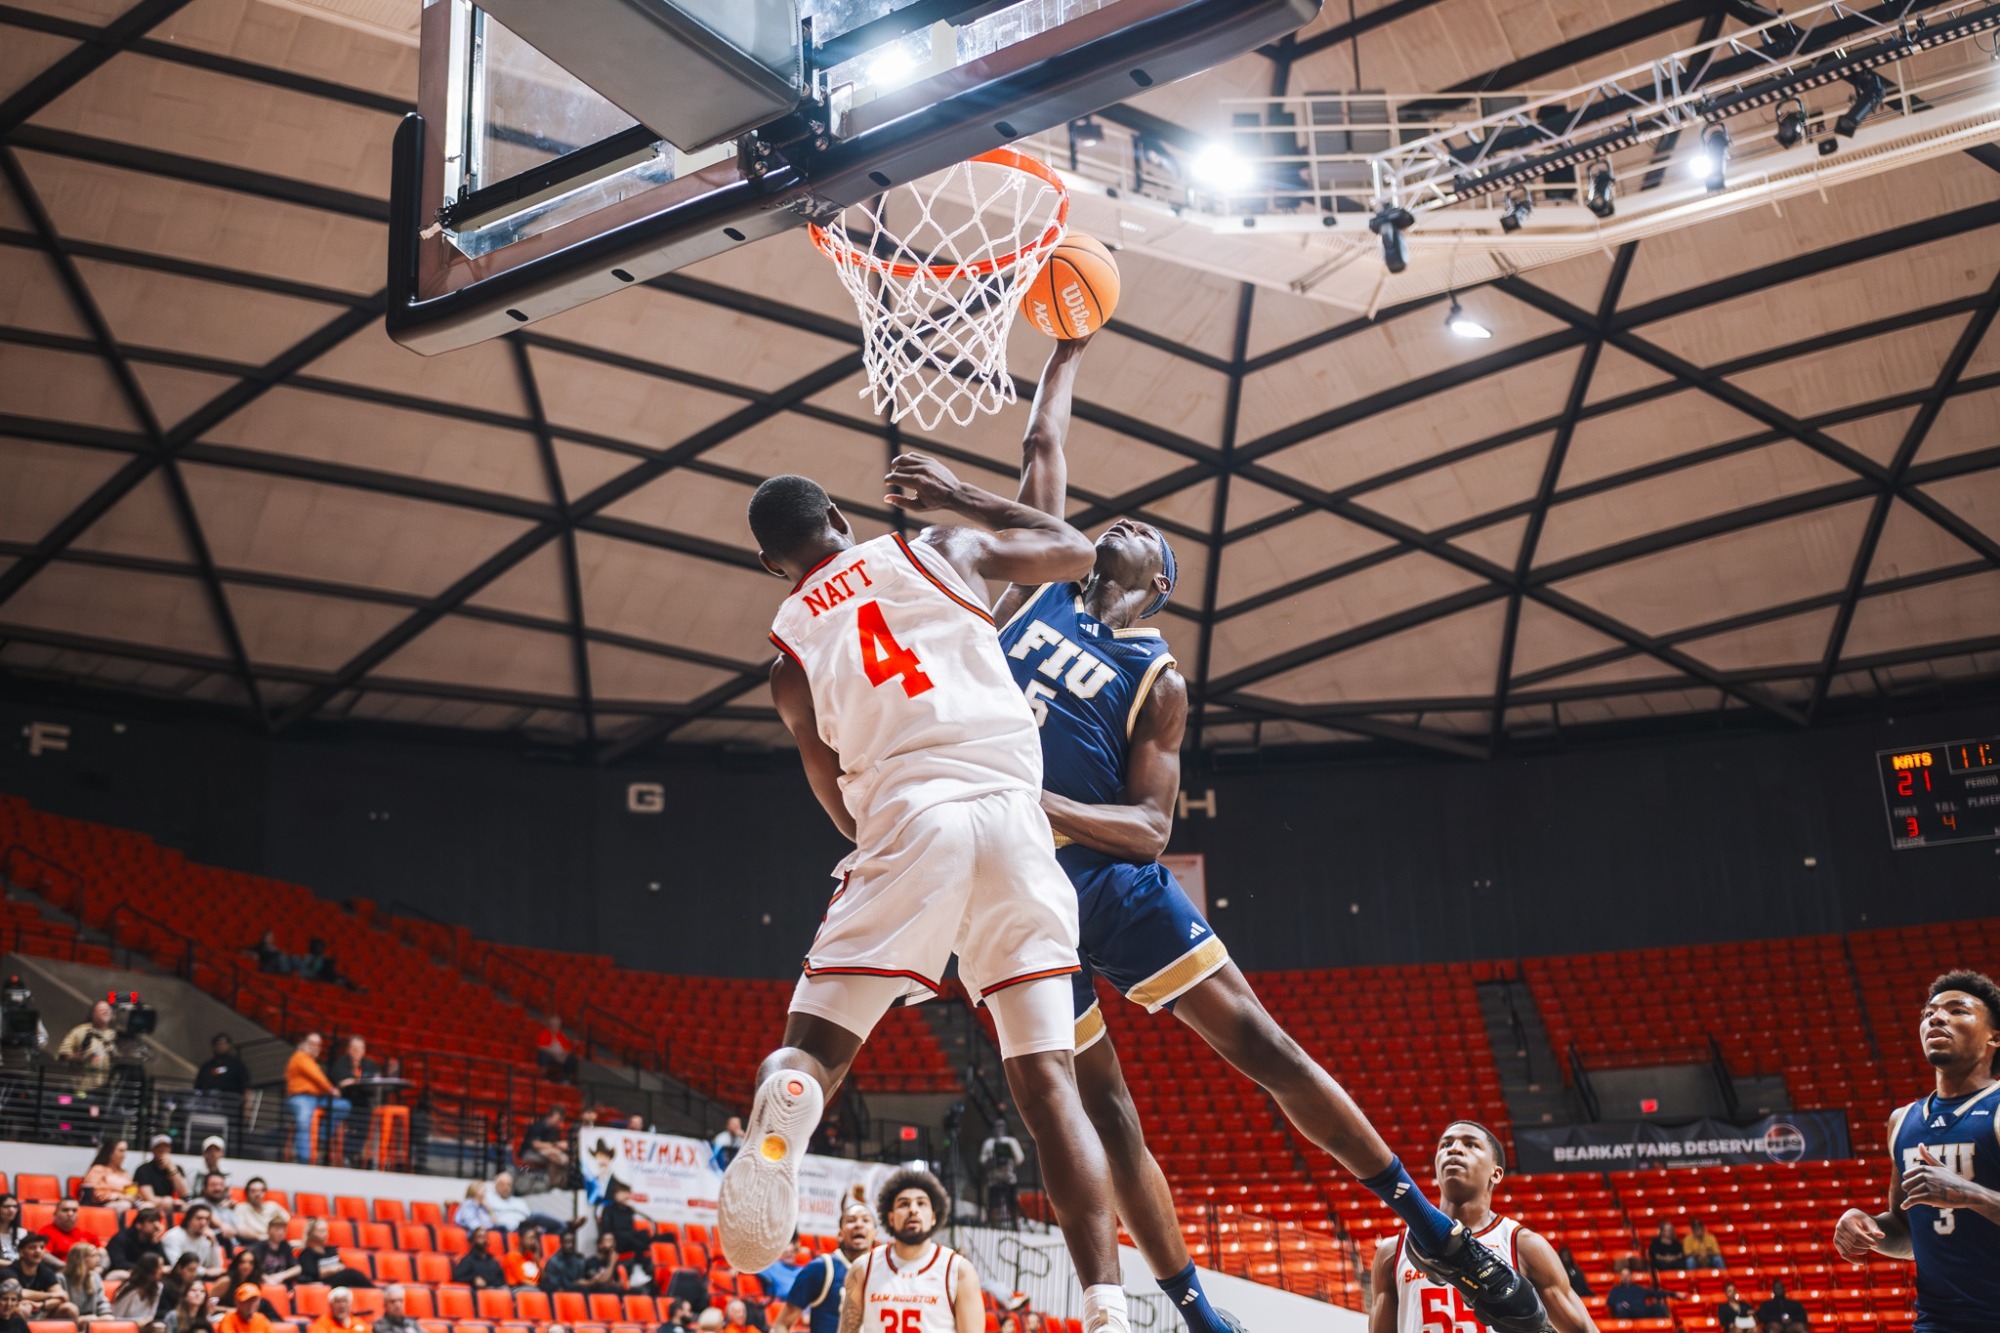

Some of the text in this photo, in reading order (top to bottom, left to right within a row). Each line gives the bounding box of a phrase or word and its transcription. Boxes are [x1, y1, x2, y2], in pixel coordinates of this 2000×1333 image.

[802, 559, 873, 617] NATT
[857, 600, 935, 699] 4
[1007, 619, 1118, 699] FIU
[1024, 678, 1057, 728] 5
[30, 722, 71, 757] F
[1892, 752, 1933, 770] KATS
[627, 782, 665, 813] G
[1897, 769, 1932, 796] 21
[1179, 789, 1216, 819] H
[623, 1137, 699, 1168] RE/MAX
[1554, 1138, 1766, 1161] BEARKAT FANS DESERVE
[1934, 1208, 1955, 1235] 3
